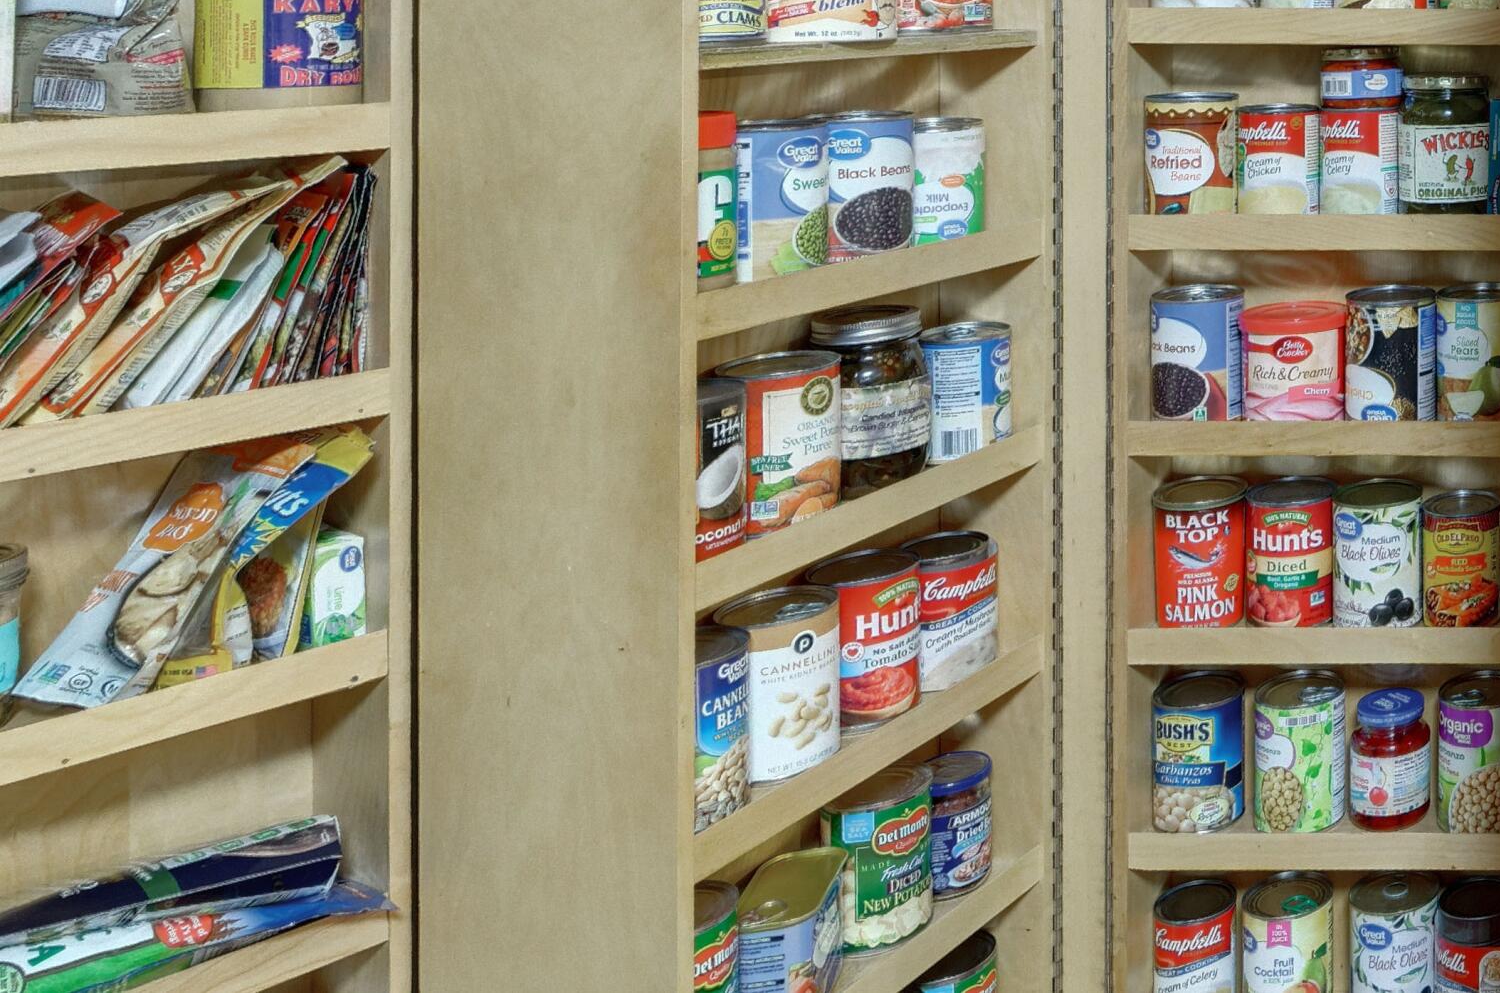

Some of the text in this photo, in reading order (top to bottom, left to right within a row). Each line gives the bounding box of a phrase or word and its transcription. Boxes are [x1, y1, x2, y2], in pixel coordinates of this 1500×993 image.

[716, 12, 762, 27] CLAMS
[280, 65, 325, 86] DRY
[828, 136, 863, 148] Great
[784, 144, 818, 157] Great
[834, 144, 863, 154] Value
[793, 154, 819, 162] Value
[1150, 156, 1202, 169] Refried
[1247, 157, 1274, 168] Cream
[837, 163, 911, 180] Black Beans
[1170, 171, 1201, 181] Beans
[1247, 165, 1281, 179] Chicken
[1327, 164, 1351, 175] Celery
[1418, 186, 1469, 198] ORIGINAL
[1456, 336, 1479, 346] Sliced
[1165, 343, 1196, 354] Beans
[1451, 345, 1479, 356] Pears
[1304, 387, 1330, 396] Cherry
[803, 440, 833, 456] Puree
[1165, 509, 1229, 528] BLACK
[1280, 513, 1308, 521] NATURAL
[1176, 525, 1219, 543] TOP
[1252, 527, 1325, 552] Hunt's
[1361, 535, 1401, 546] Medium
[1341, 544, 1401, 560] Black Olives
[1267, 559, 1307, 572] Diced
[1177, 584, 1218, 603] PINK
[1165, 596, 1235, 622] SALMON
[929, 618, 958, 630] GREAT
[889, 640, 905, 652] Salt
[760, 645, 836, 677] CANNELLINI
[862, 649, 906, 670] Tomato
[1156, 721, 1210, 740] BUSH'S
[1155, 762, 1213, 776] Garbanzos
[878, 832, 898, 845] Del
[863, 897, 892, 913] NEW
[1361, 928, 1386, 940] Great
[1392, 936, 1428, 954] Medium
[1273, 958, 1294, 968] Fruit
[1369, 955, 1397, 971] Black
[1254, 966, 1295, 977] Cocktail
